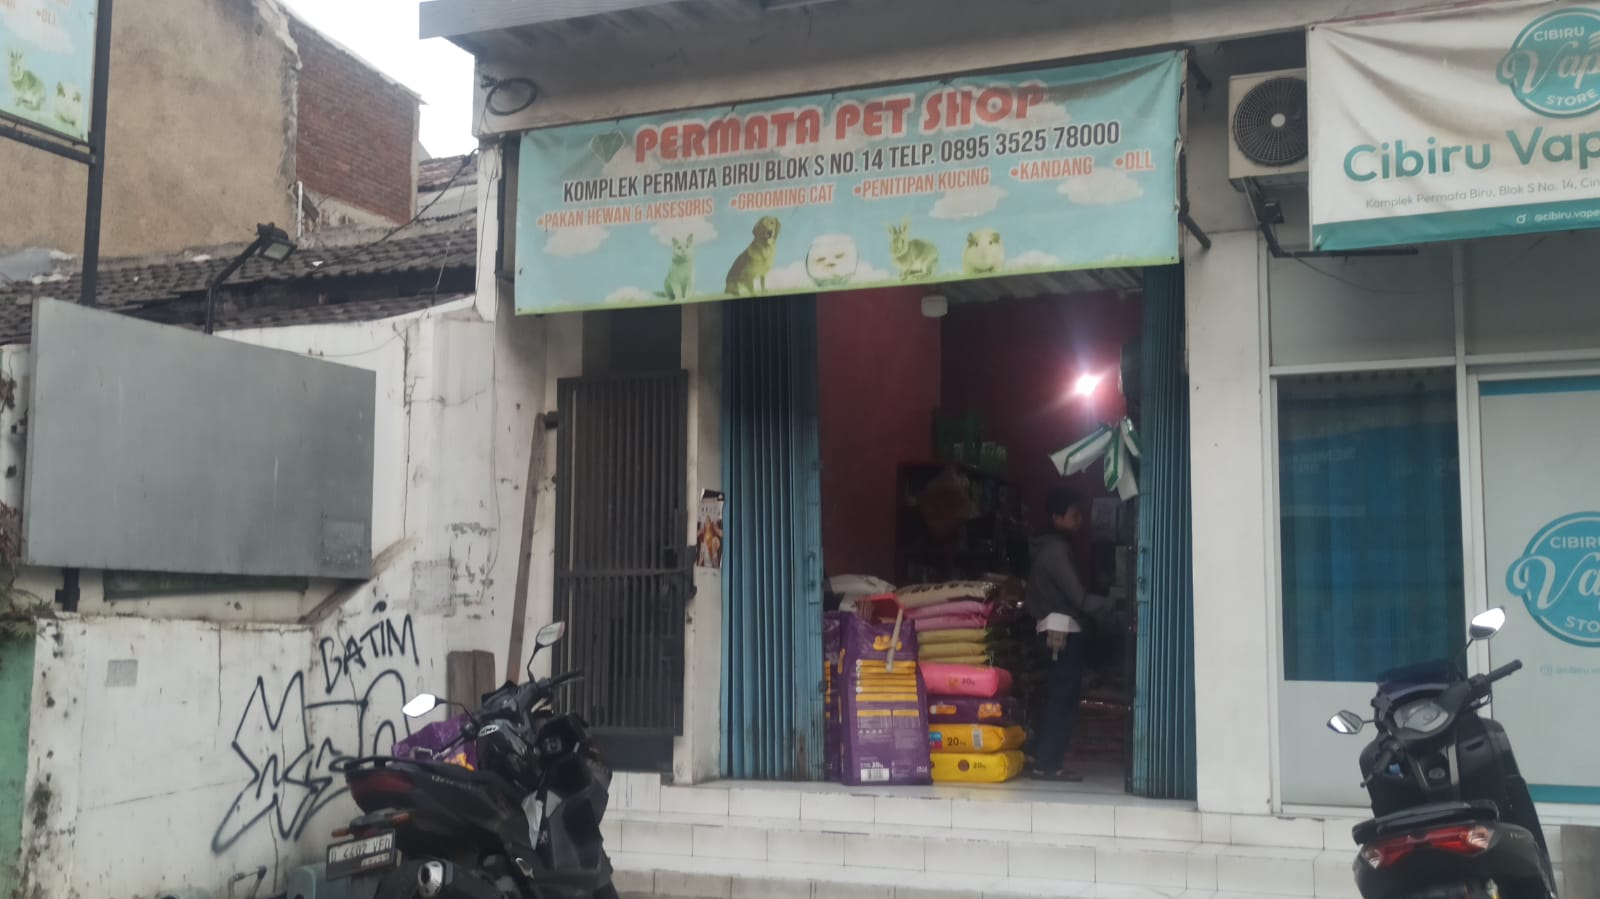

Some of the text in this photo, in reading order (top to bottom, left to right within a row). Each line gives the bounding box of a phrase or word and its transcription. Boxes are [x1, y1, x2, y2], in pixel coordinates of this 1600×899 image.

[1534, 26, 1585, 41] CIBIRU
[1545, 88, 1598, 106] STORE
[635, 84, 1048, 163] PERMATA PET SHOP
[564, 121, 1120, 202] KOMPLEK PERMATA BIRU BLOK S NO. 14 TELP. 0895 3525 78000
[1343, 136, 1491, 181] Cibiru
[587, 204, 630, 226] HEWAN
[635, 204, 642, 221] &
[646, 198, 713, 220] AKSESORIS
[738, 187, 806, 211] GROOMING
[810, 184, 834, 204] CAT
[863, 173, 934, 199] PENITIPAN
[938, 167, 990, 190] KUCING
[1020, 156, 1093, 181] KANDANG
[1125, 150, 1154, 171] DLL
[1366, 197, 1412, 209] Komplek
[1417, 192, 1466, 203] Permata
[1499, 184, 1523, 196] Blok
[1528, 183, 1535, 193] S
[1550, 536, 1600, 549] CIBIR
[947, 736, 959, 747] 20
